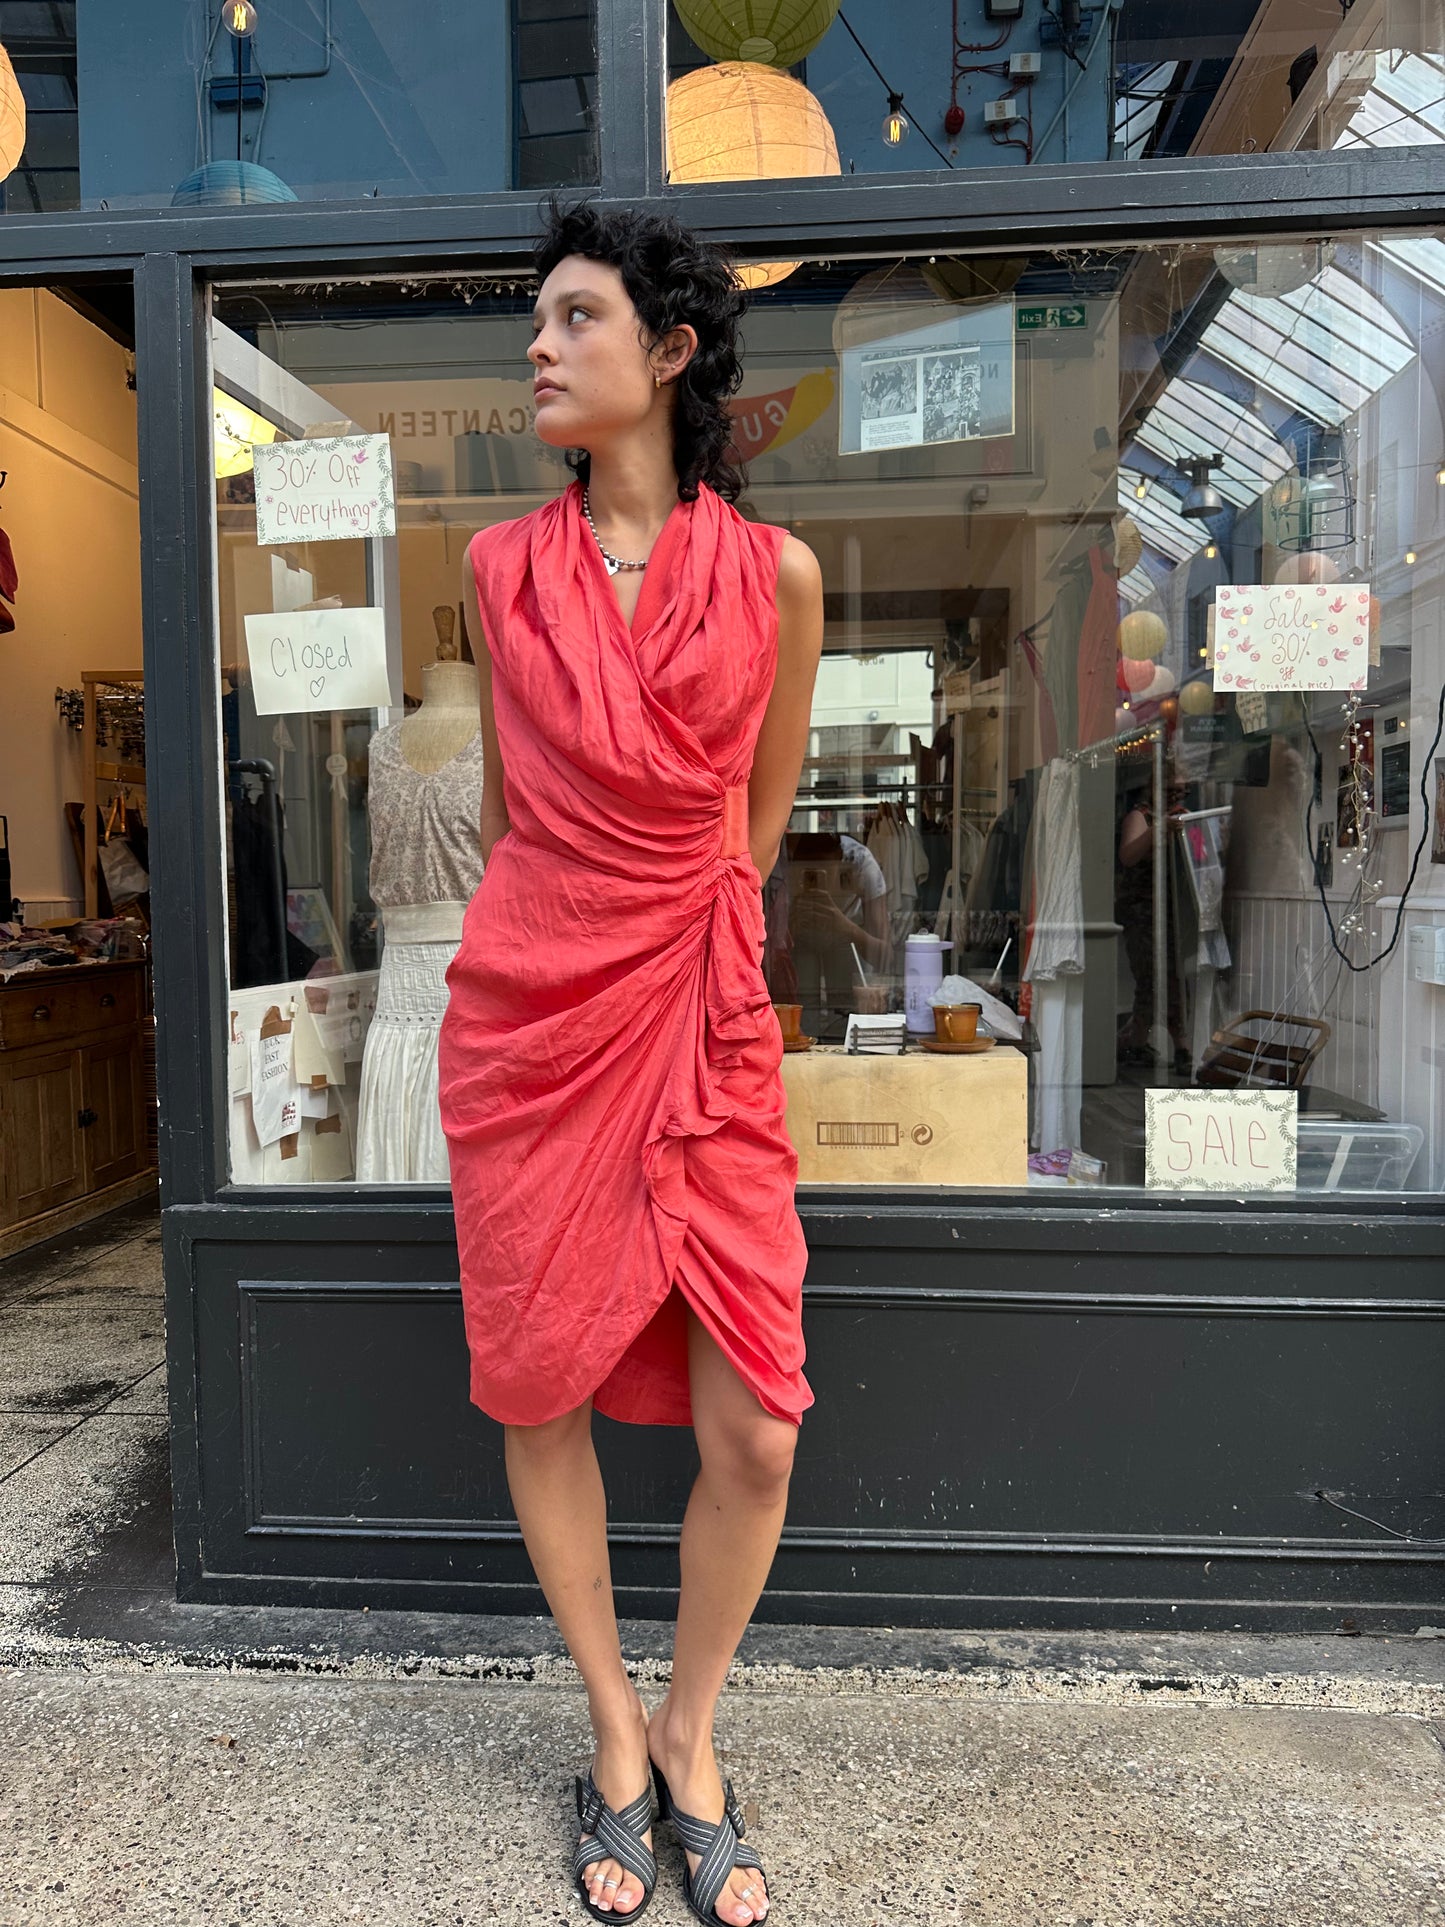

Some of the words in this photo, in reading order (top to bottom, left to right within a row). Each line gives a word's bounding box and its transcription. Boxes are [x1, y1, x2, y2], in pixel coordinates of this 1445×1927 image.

[268, 454, 317, 491] 30%
[328, 453, 361, 488] Off
[276, 498, 370, 531] everything
[1263, 595, 1326, 630] Sale
[270, 635, 352, 677] Closed
[1271, 631, 1311, 665] 30%
[1279, 665, 1295, 681] off
[260, 1061, 289, 1082] FASHION
[264, 1050, 280, 1065] FAST
